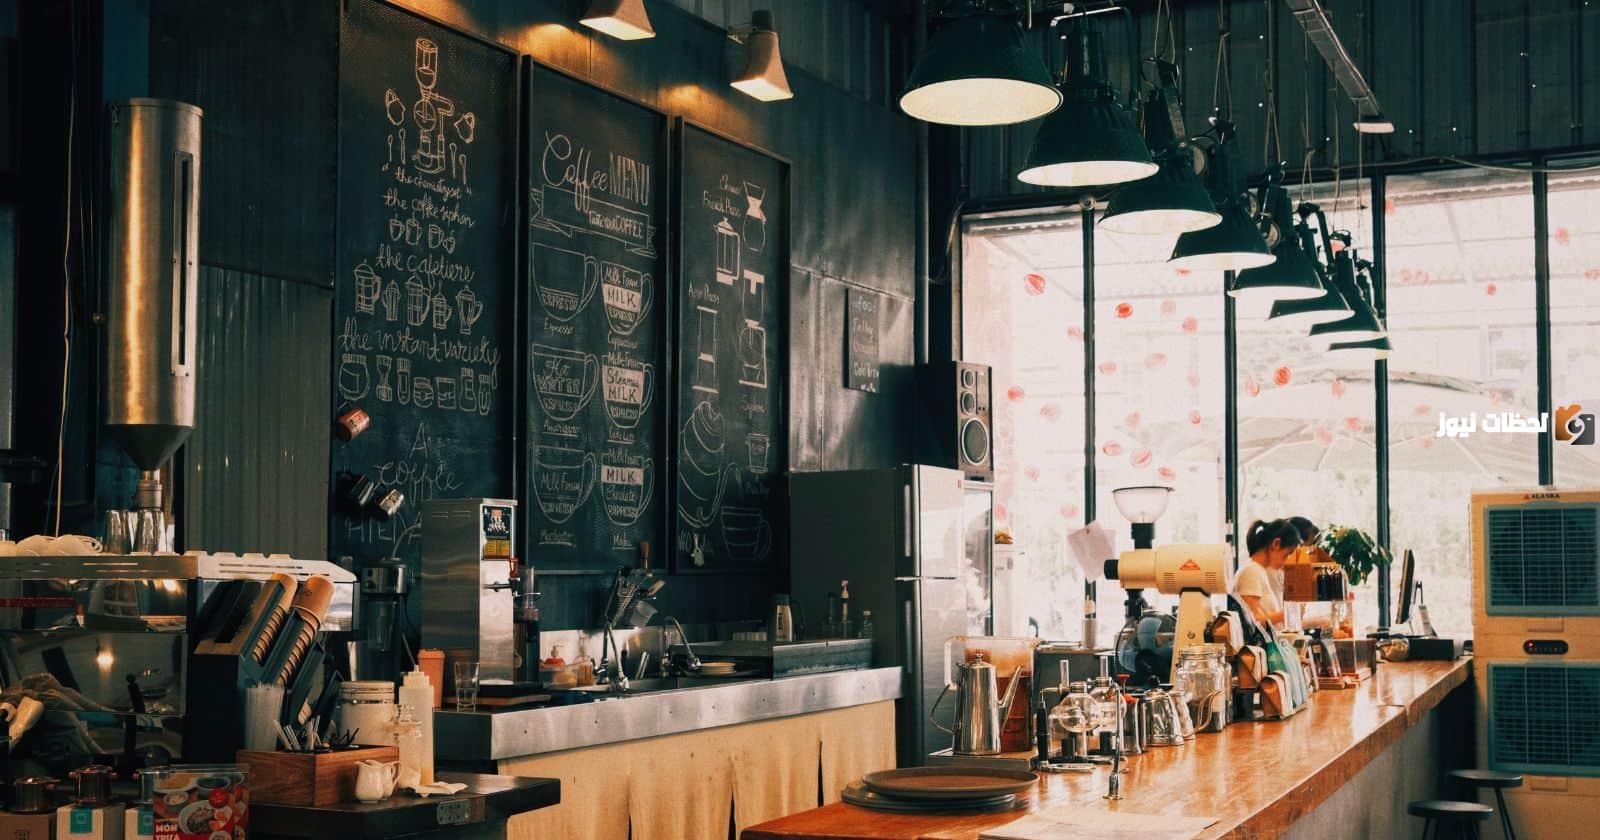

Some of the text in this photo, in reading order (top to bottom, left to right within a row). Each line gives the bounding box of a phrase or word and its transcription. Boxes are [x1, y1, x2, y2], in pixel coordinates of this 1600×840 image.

[542, 130, 650, 212] Coffee MENU
[607, 287, 637, 308] MILK
[608, 385, 637, 403] MILK
[606, 468, 635, 483] MILK
